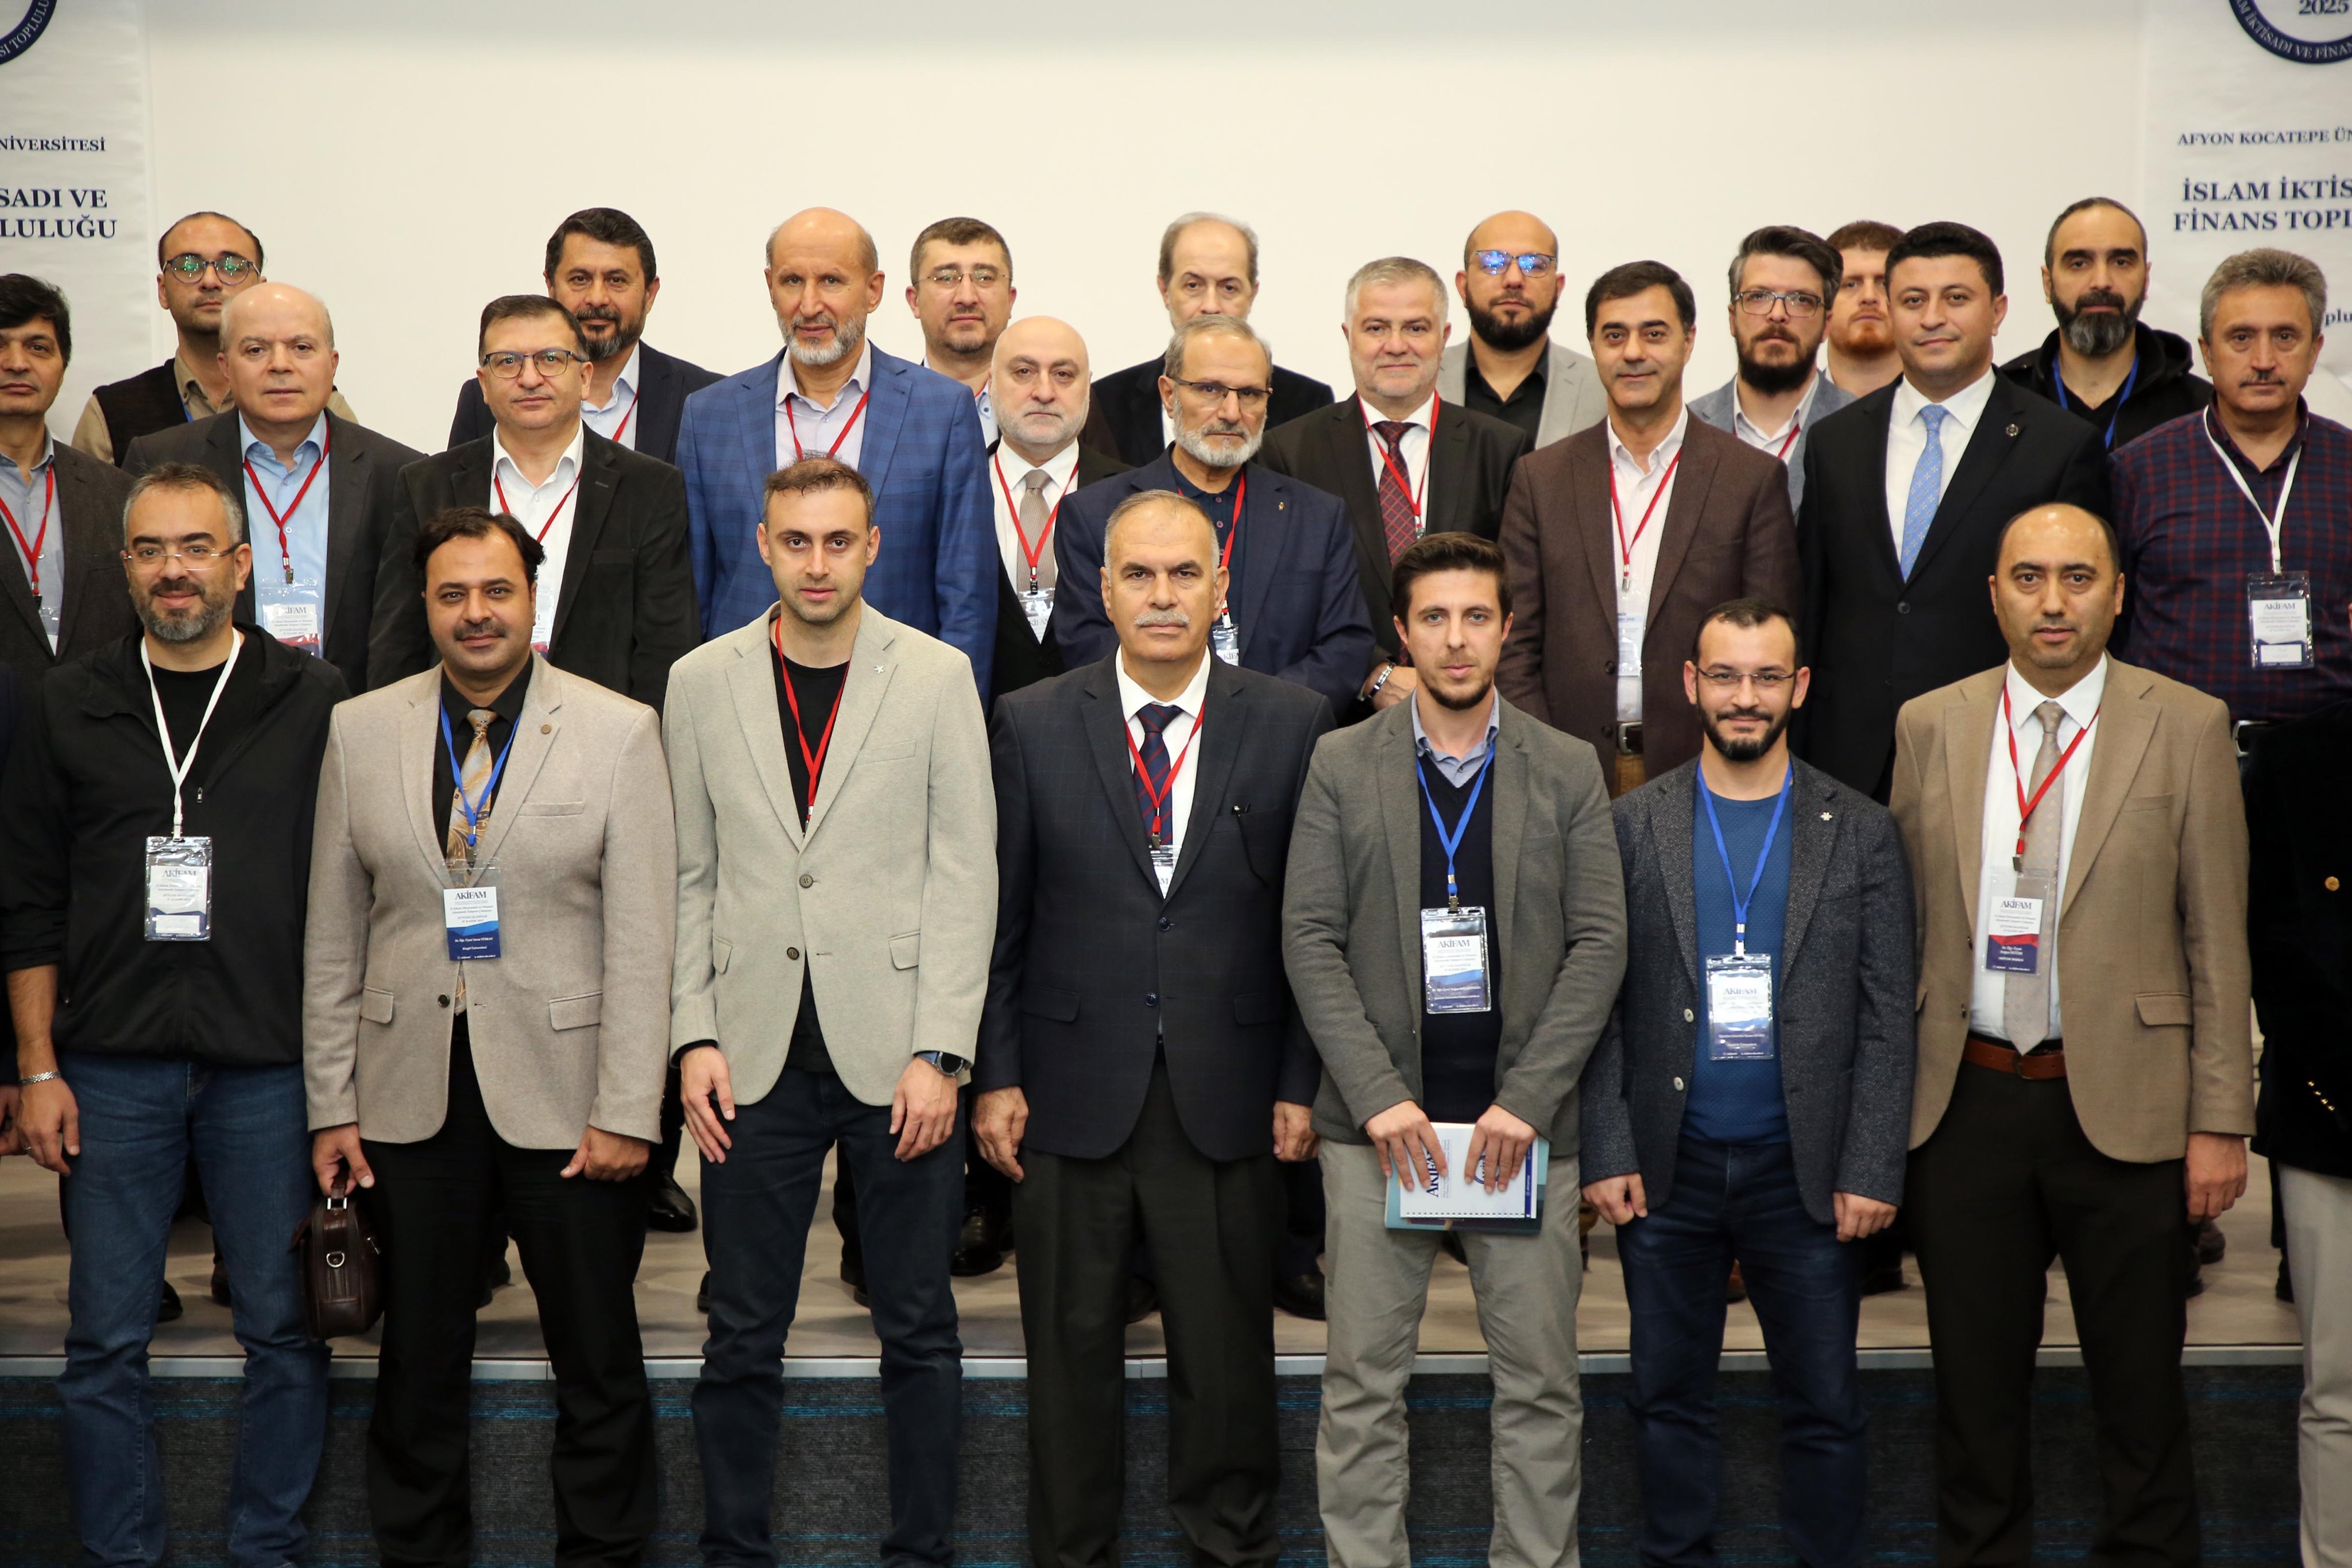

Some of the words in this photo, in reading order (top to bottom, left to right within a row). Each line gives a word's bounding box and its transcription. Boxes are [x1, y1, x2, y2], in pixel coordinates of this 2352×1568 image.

[2299, 0, 2350, 15] 2025
[2179, 133, 2234, 145] AFYON
[2241, 130, 2330, 144] KOCATEPE
[68, 188, 107, 208] VE
[2183, 177, 2270, 202] İSLAM
[0, 213, 117, 238] LULUĞU
[2175, 207, 2277, 231] FİNANS
[454, 891, 487, 900] AKİFAM
[1438, 939, 1470, 948] AKİFAM
